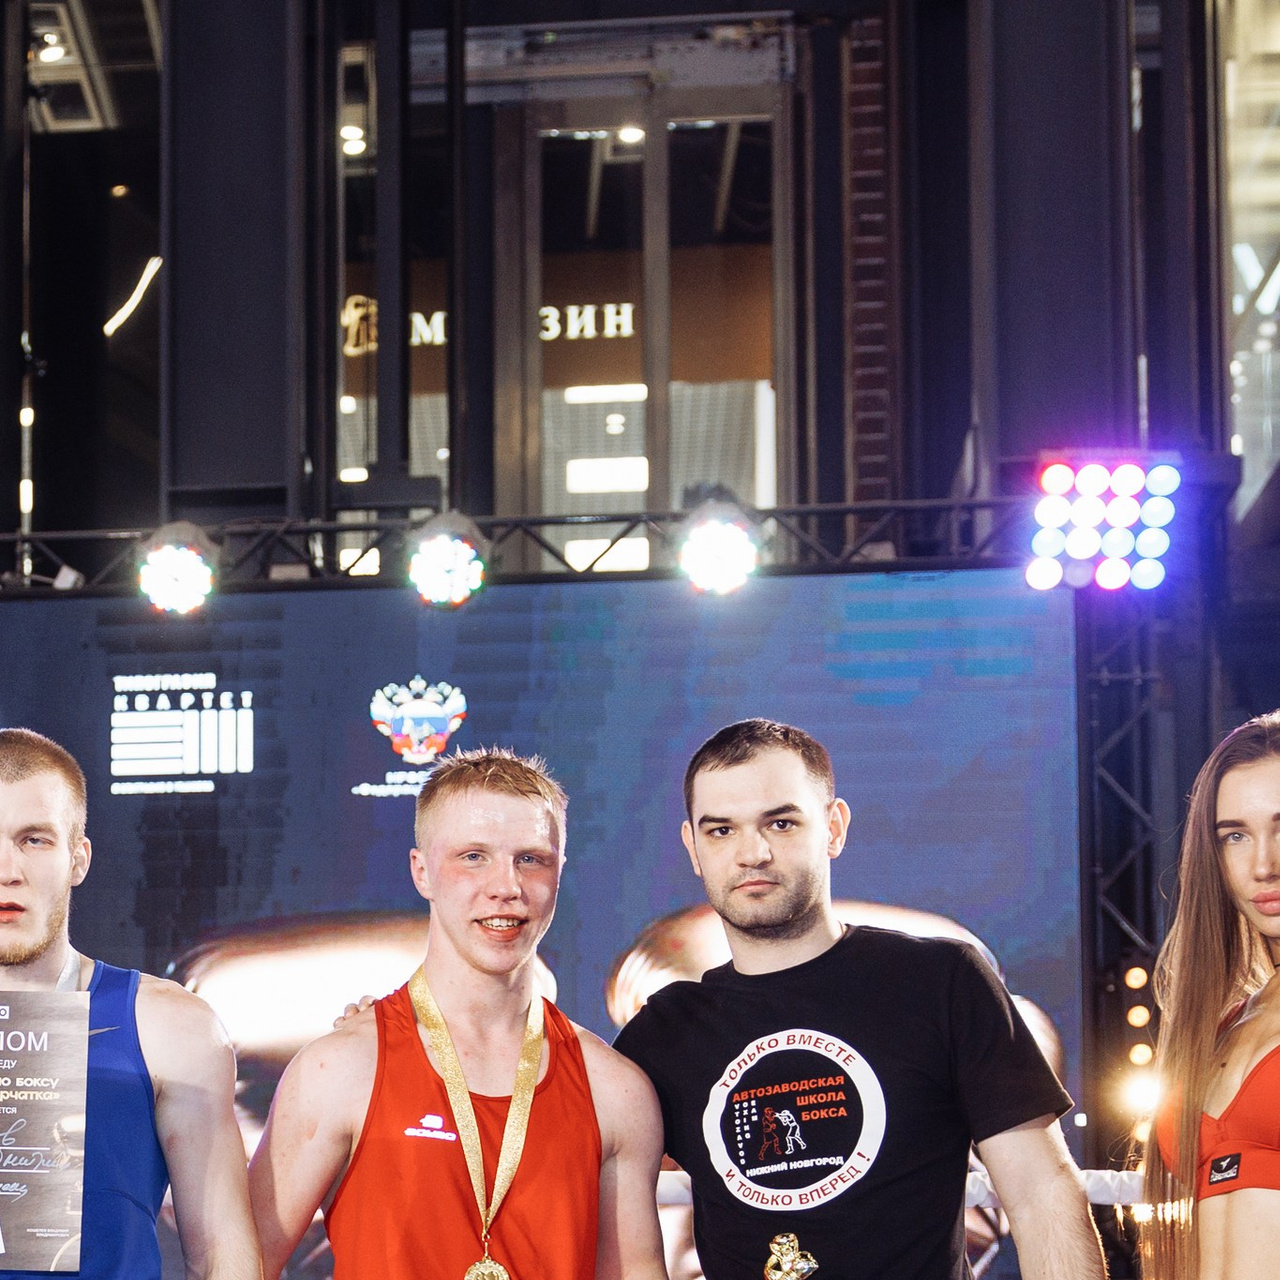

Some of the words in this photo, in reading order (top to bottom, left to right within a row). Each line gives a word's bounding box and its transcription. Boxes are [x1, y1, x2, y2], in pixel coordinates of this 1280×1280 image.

[719, 1037, 779, 1090] ТОЛЬКО
[786, 1033, 857, 1067] ВМЕСТЕ
[16, 1076, 60, 1089] боксу
[732, 1075, 845, 1103] АВТОЗАВОДСКАЯ
[796, 1091, 846, 1107] ШКОЛА
[801, 1107, 848, 1122] БОКСА
[745, 1160, 789, 1178] НИЖНИЙ
[789, 1155, 846, 1172] НОВГОРОД
[724, 1168, 736, 1183] И
[736, 1181, 794, 1207] ТОЛЬКО
[798, 1165, 863, 1206] ВПЕРЕД
